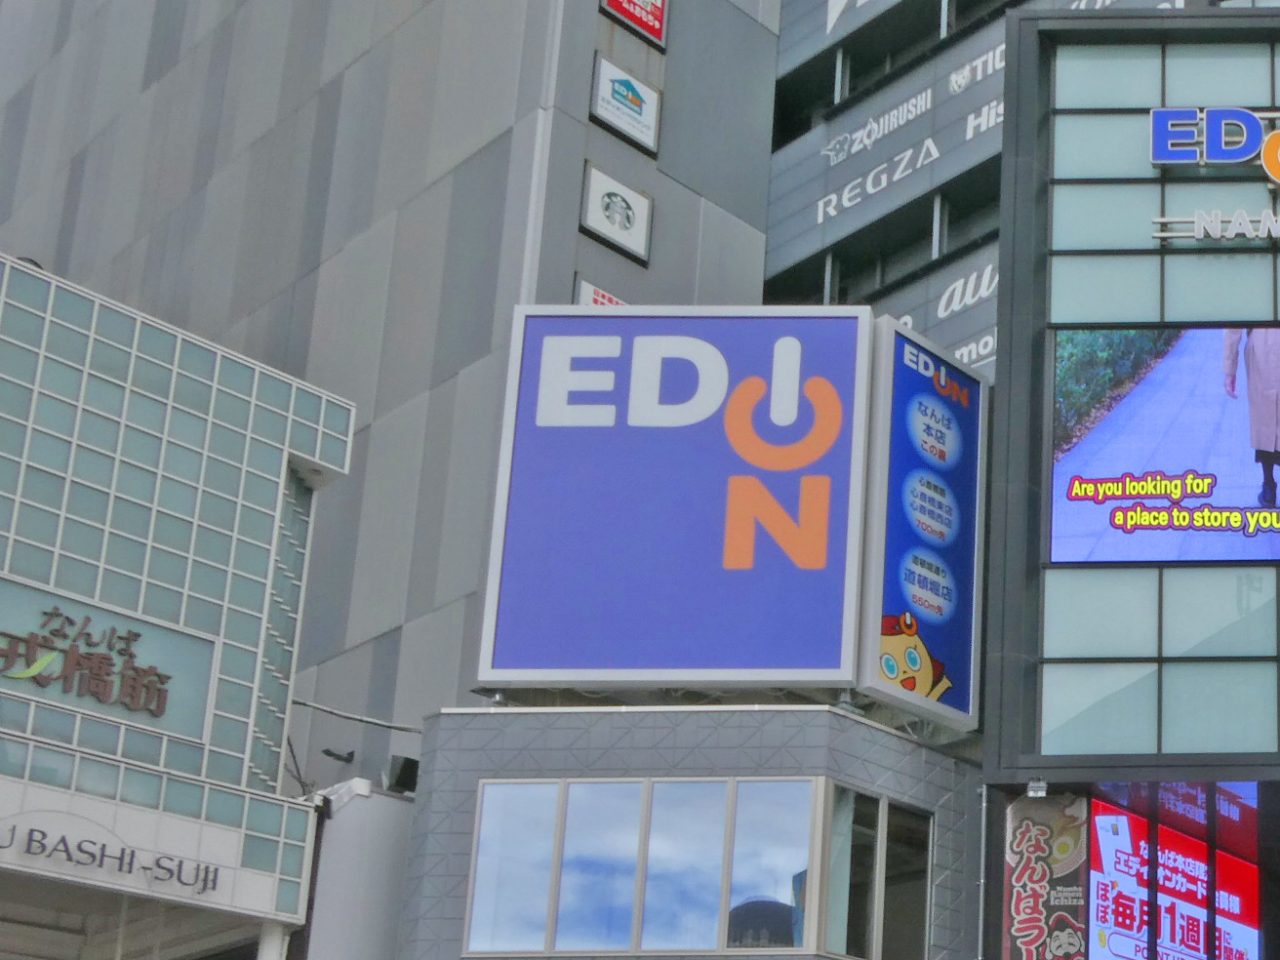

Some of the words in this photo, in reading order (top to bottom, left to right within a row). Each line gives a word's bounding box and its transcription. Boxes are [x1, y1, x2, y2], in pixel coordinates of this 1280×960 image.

[851, 88, 932, 154] ZOJIRUSHI
[817, 137, 940, 225] REGZA
[937, 264, 998, 318] au
[903, 343, 970, 408] EDION
[1071, 478, 1095, 498] Are
[1097, 481, 1122, 501] you
[1125, 476, 1181, 500] looking
[1184, 474, 1212, 495] for
[1114, 511, 1123, 526] a
[1127, 508, 1168, 530] place
[1173, 508, 1189, 527] to
[1193, 508, 1241, 529] store
[41, 606, 142, 658] なんば
